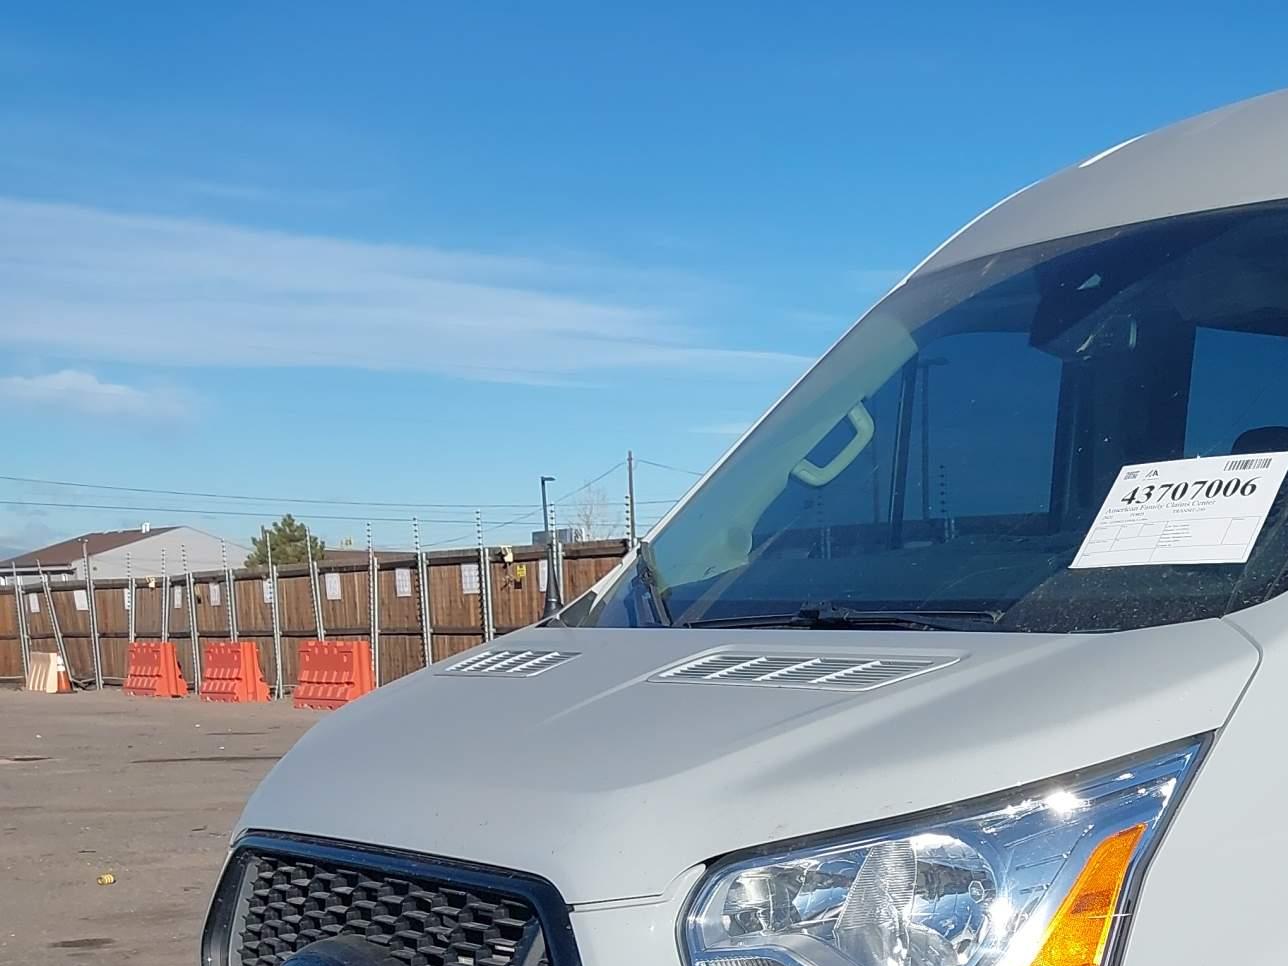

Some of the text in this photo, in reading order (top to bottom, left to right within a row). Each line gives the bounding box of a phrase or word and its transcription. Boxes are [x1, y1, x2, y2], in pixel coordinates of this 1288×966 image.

[1121, 476, 1262, 505] 43707006
[1166, 501, 1190, 509] Claims
[1192, 499, 1217, 507] Center
